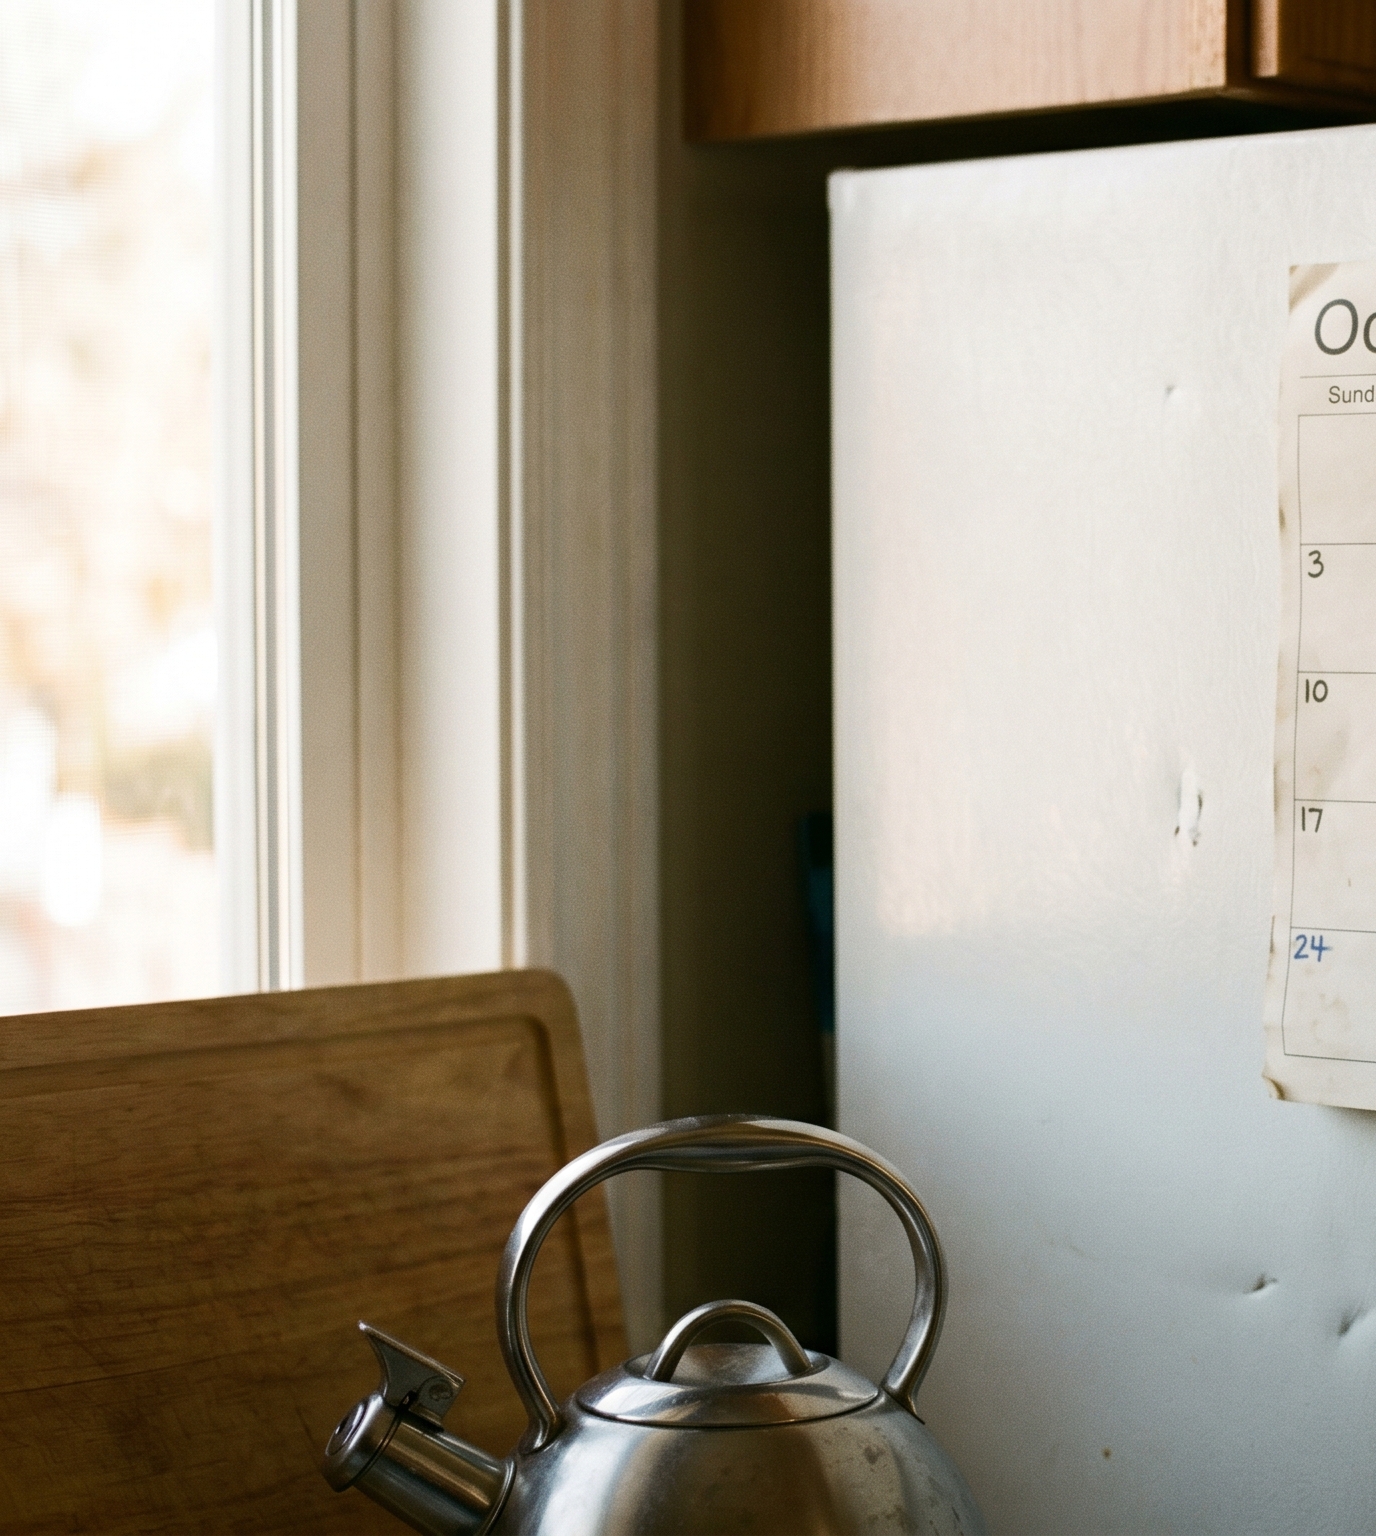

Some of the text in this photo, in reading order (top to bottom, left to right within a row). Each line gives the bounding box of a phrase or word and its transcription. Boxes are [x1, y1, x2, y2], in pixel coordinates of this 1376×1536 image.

[1308, 550, 1324, 578] 3
[1305, 679, 1328, 703] 10
[1301, 806, 1323, 832] 17
[1294, 934, 1330, 962] 24
